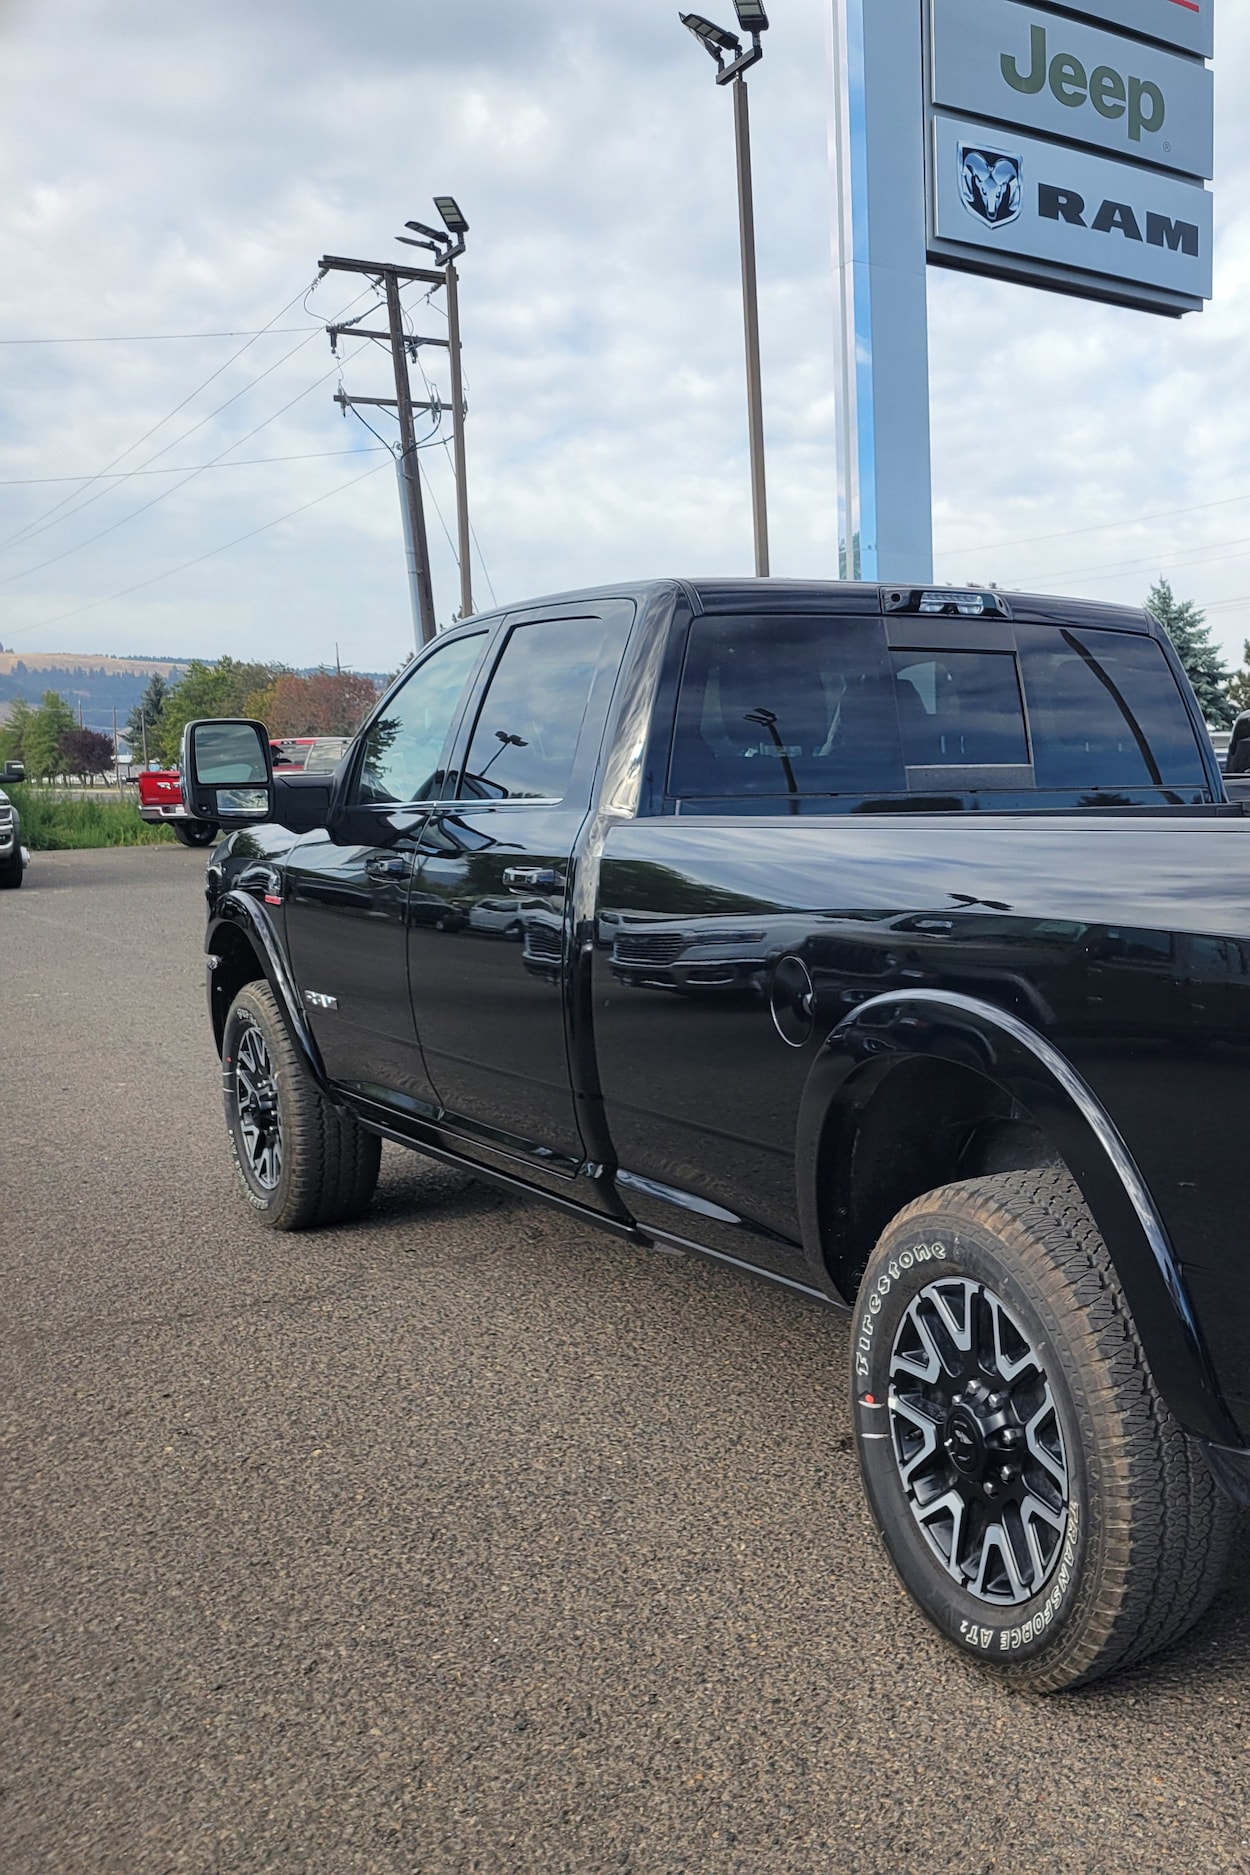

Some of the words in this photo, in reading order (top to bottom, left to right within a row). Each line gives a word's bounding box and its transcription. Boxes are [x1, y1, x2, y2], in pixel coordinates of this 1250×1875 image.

[1000, 24, 1165, 142] Jeep
[1038, 182, 1198, 258] RAM
[856, 1241, 946, 1376] Firestone
[1000, 1502, 1079, 1651] TRANSFORCE
